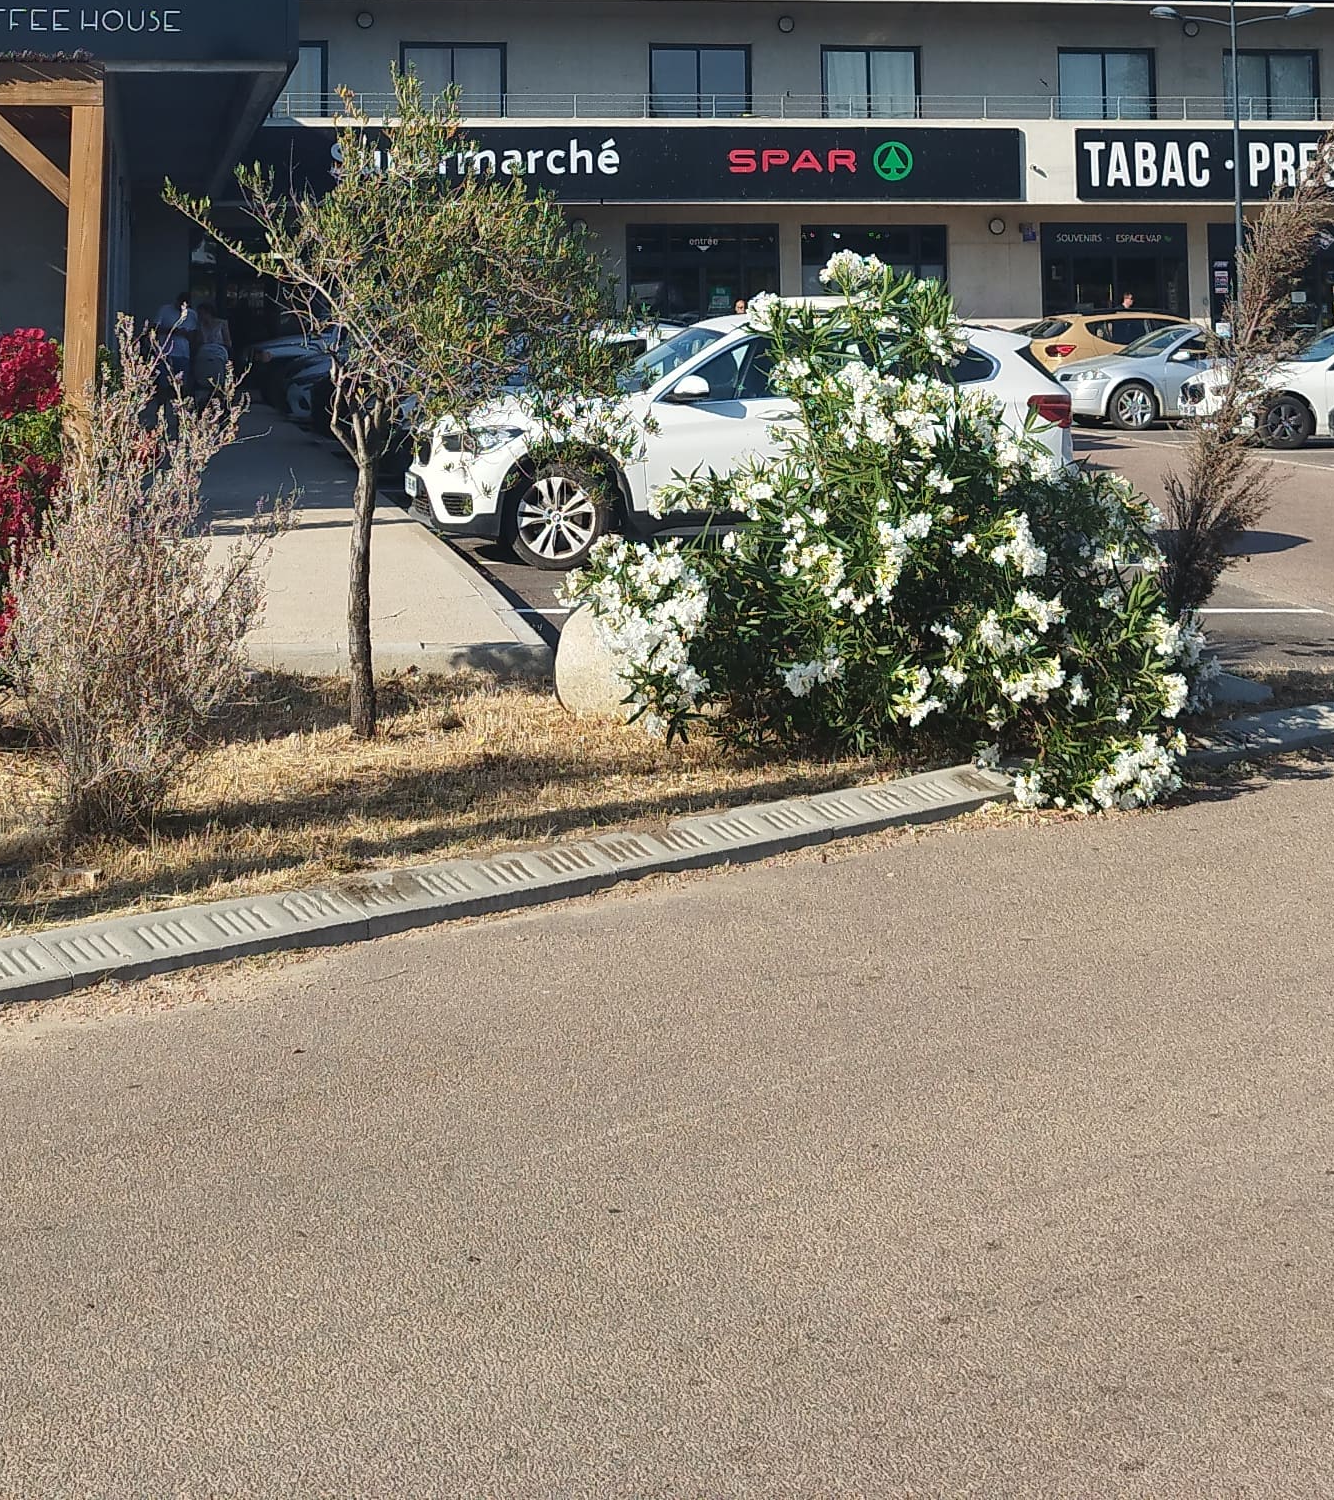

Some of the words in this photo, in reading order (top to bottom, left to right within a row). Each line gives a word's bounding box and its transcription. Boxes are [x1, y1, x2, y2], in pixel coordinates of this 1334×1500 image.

[80, 8, 182, 32] HOUSE
[330, 138, 620, 179] urmarché
[728, 148, 857, 173] SPAR
[1083, 141, 1210, 188] TABAC
[1056, 233, 1103, 243] SOUVENIRS
